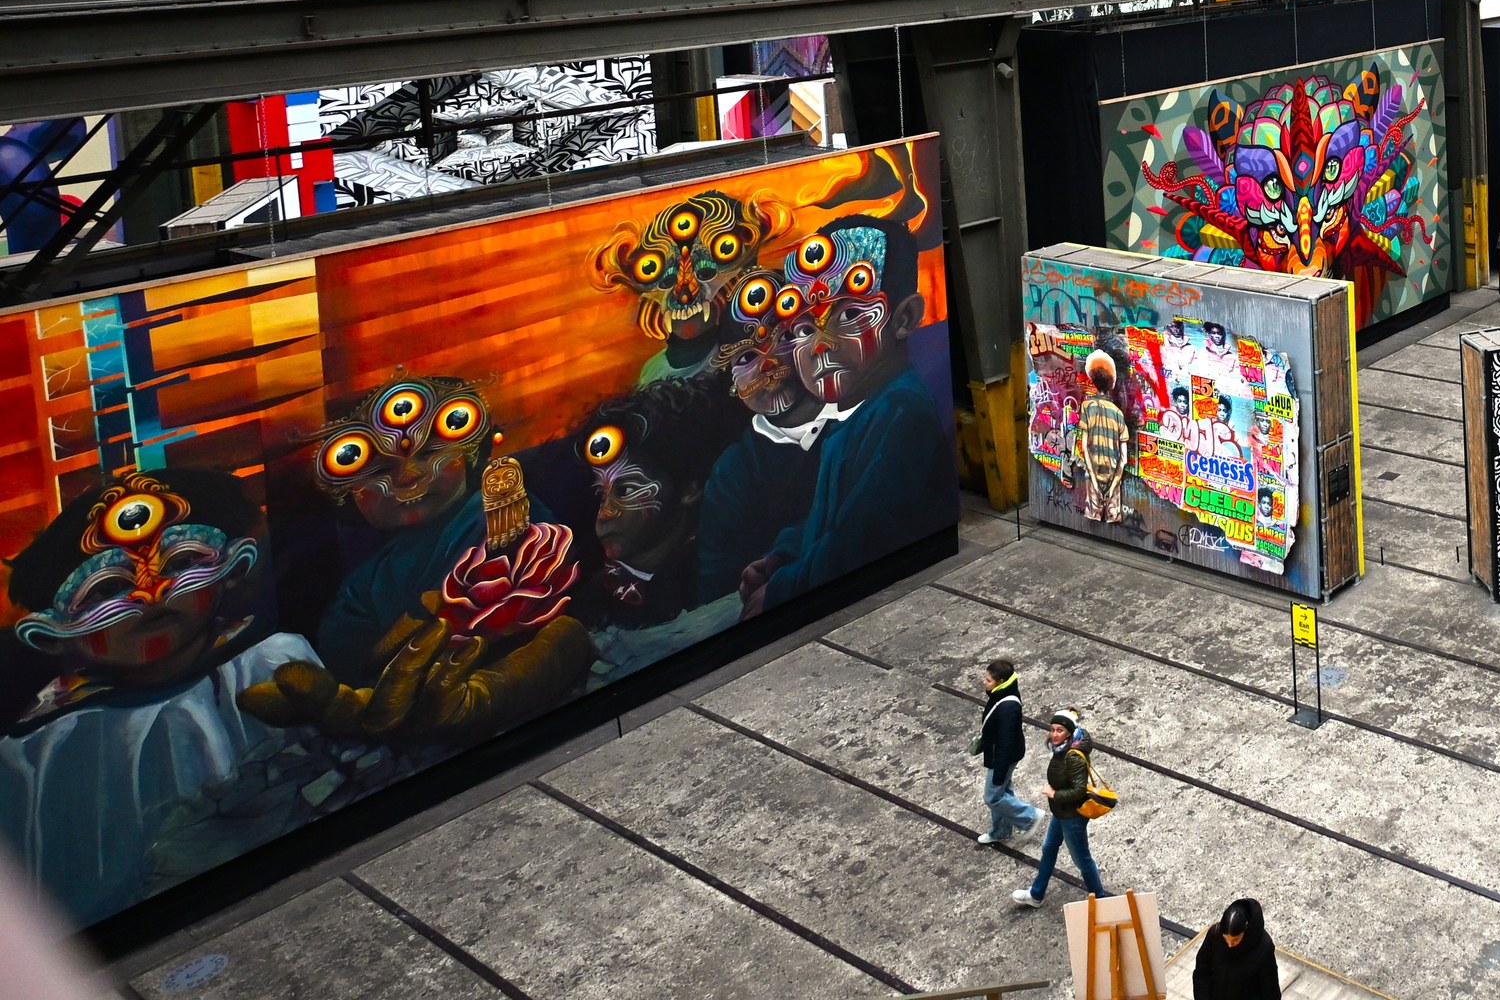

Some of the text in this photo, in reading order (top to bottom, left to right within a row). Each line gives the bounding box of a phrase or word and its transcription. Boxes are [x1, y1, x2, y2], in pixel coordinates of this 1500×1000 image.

[1146, 434, 1158, 454] 5
[1187, 451, 1255, 492] Genesis
[1185, 485, 1256, 516] CIELO
[1298, 621, 1310, 630] Exit
